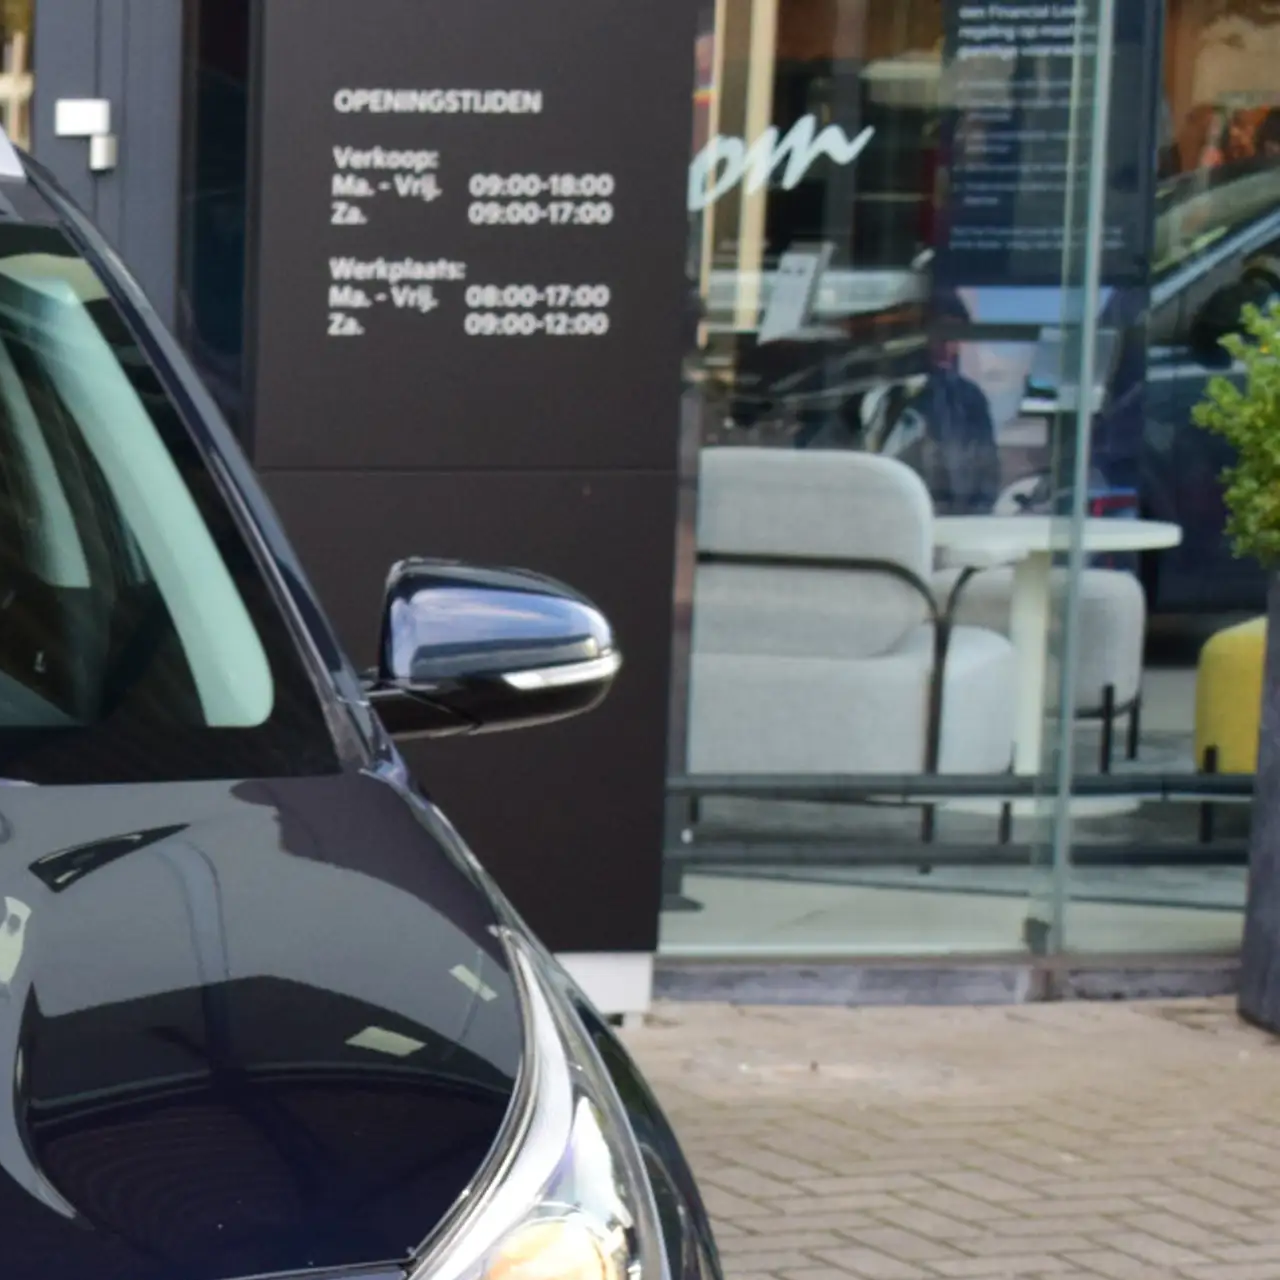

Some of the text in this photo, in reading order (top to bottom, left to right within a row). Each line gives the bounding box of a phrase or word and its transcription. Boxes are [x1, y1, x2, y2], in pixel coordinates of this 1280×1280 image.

[334, 89, 542, 113] OPENINGSTIJDEN
[333, 146, 438, 173] Verkoop:
[332, 173, 375, 197] Ma.
[394, 173, 442, 201] Vrij.
[469, 173, 614, 197] 09:00-18:00
[331, 201, 613, 225] Za. 09:00-17:00
[329, 257, 466, 284] Werkplaats:
[329, 285, 372, 308] Ma.
[391, 285, 438, 313] Vrij.
[465, 285, 610, 307] 08:00-17:00
[328, 312, 609, 335] Za. 09:00-12:00
